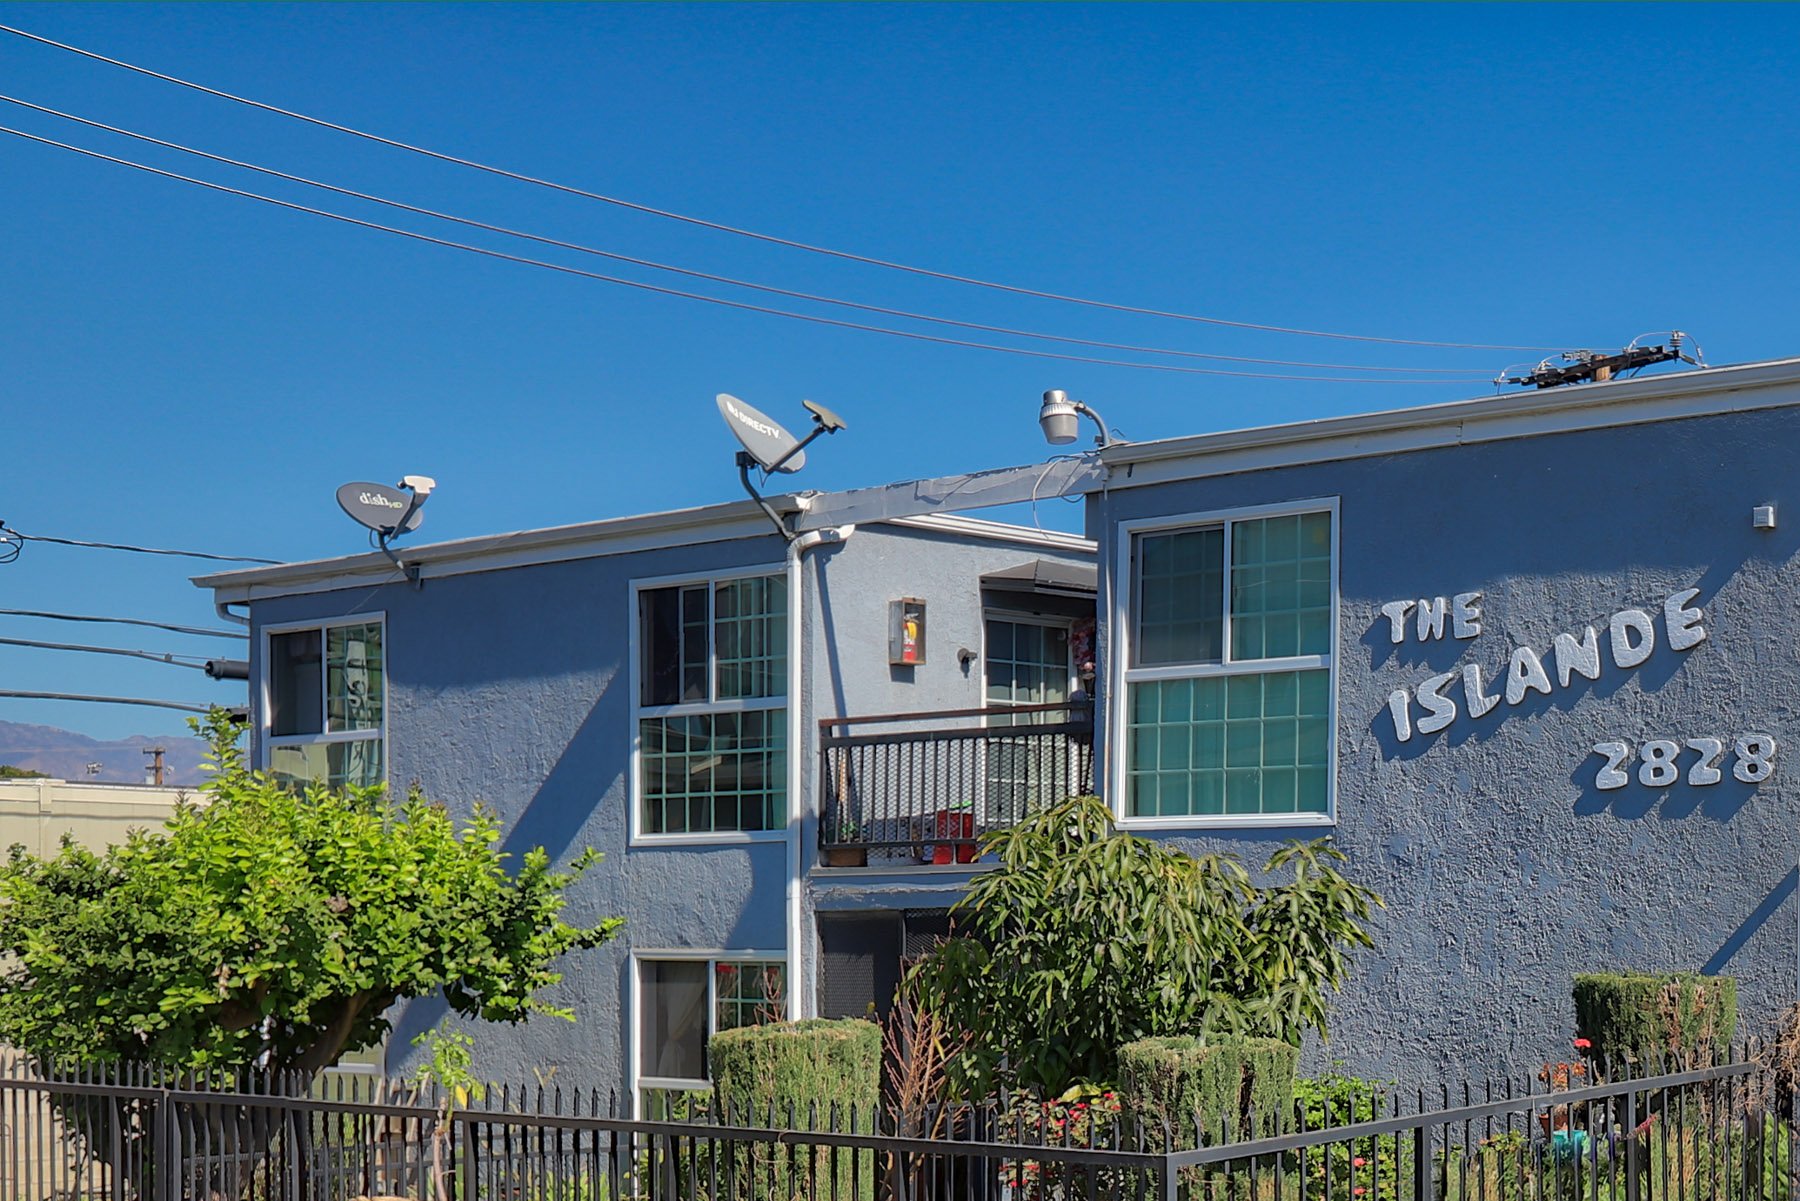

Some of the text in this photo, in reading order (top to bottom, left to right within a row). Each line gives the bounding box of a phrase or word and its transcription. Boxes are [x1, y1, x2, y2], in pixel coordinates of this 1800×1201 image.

[740, 413, 780, 439] DIRECTV
[1381, 592, 1482, 643] THE
[1388, 587, 1706, 742] ISLANDE
[1593, 734, 1776, 790] 2828
